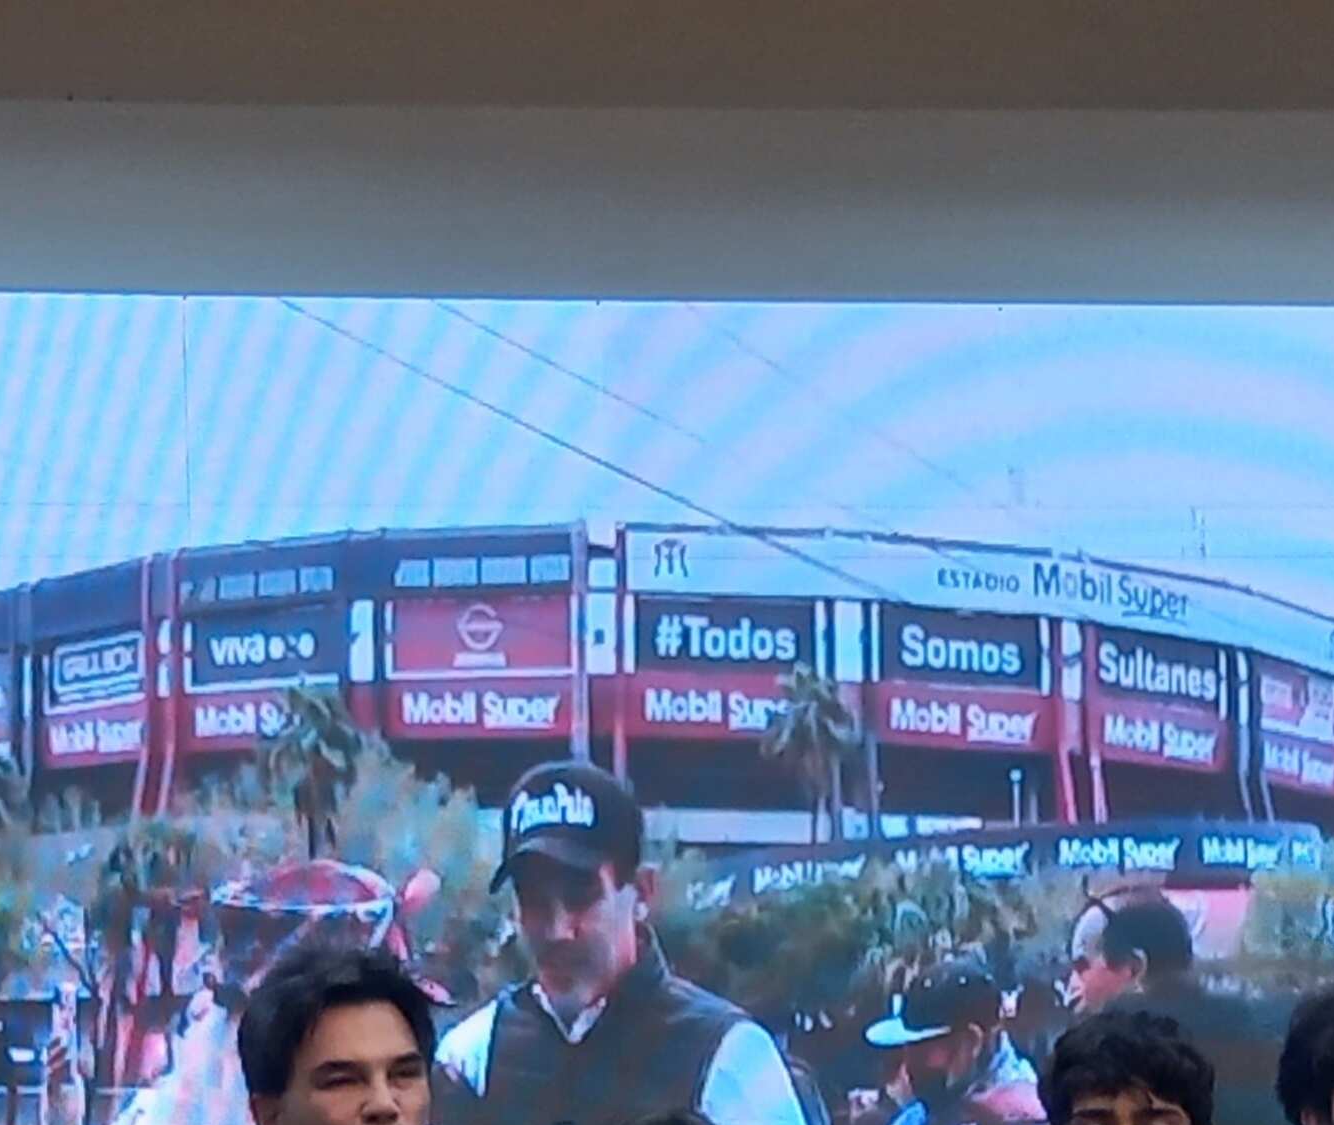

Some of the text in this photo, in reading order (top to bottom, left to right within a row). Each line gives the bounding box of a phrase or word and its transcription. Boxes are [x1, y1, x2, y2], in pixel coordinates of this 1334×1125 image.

[936, 562, 1190, 621] ESTADIO Mobil Super
[654, 613, 797, 660] #Todos
[900, 623, 1022, 674] Somos
[1098, 641, 1216, 700] Sultanes
[402, 690, 560, 729] Mobil Super
[644, 687, 722, 722] Mobil
[889, 697, 1038, 745] Mobil Super
[1104, 713, 1159, 752] Mobil
